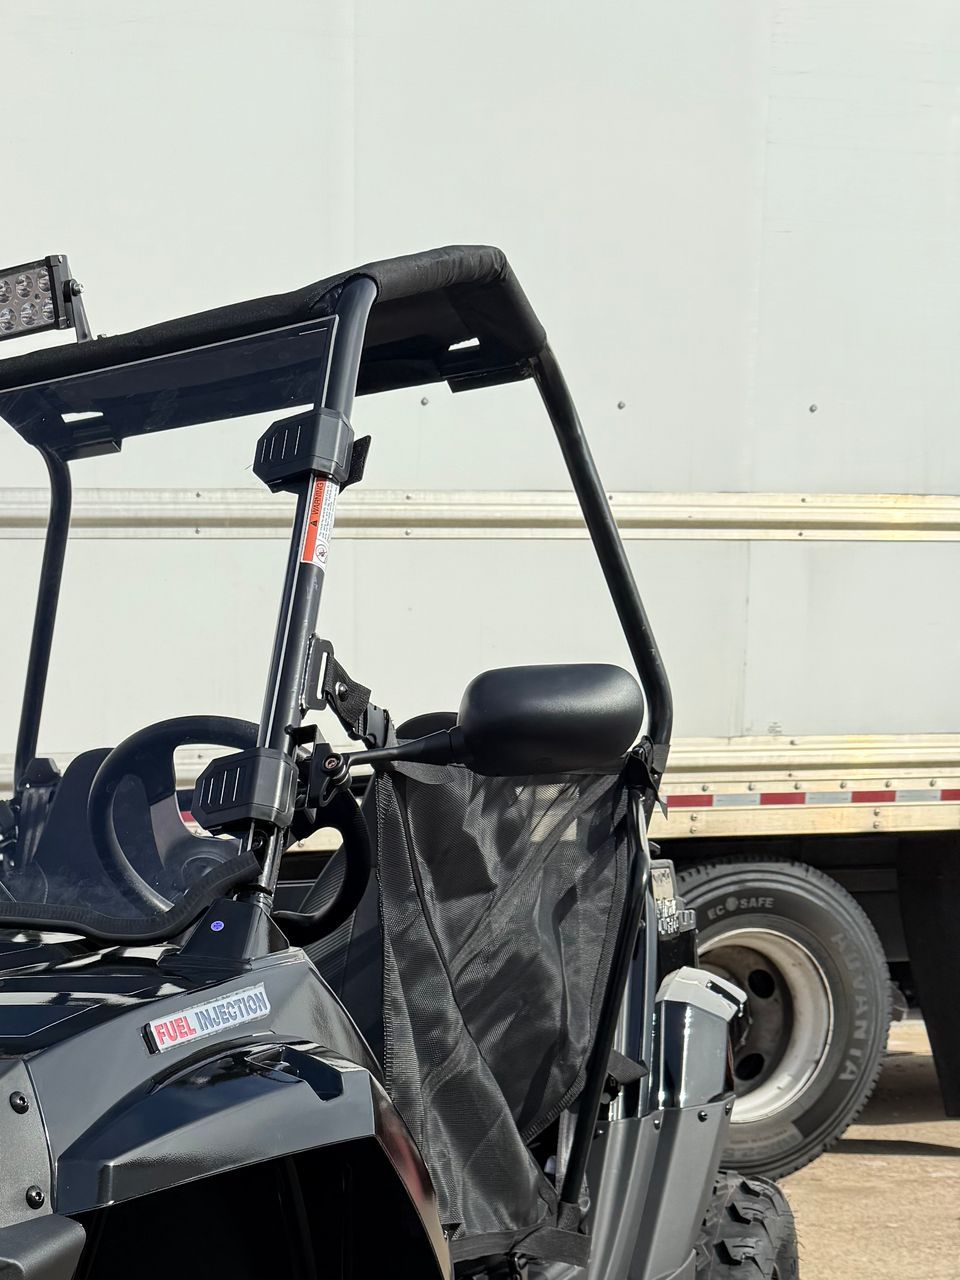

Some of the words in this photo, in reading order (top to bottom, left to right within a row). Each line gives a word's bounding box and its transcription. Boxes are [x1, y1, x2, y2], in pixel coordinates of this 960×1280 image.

[311, 482, 324, 515] WARNING
[740, 897, 774, 909] SAFE
[154, 1015, 196, 1045] FUEL
[195, 992, 268, 1031] INJECTION
